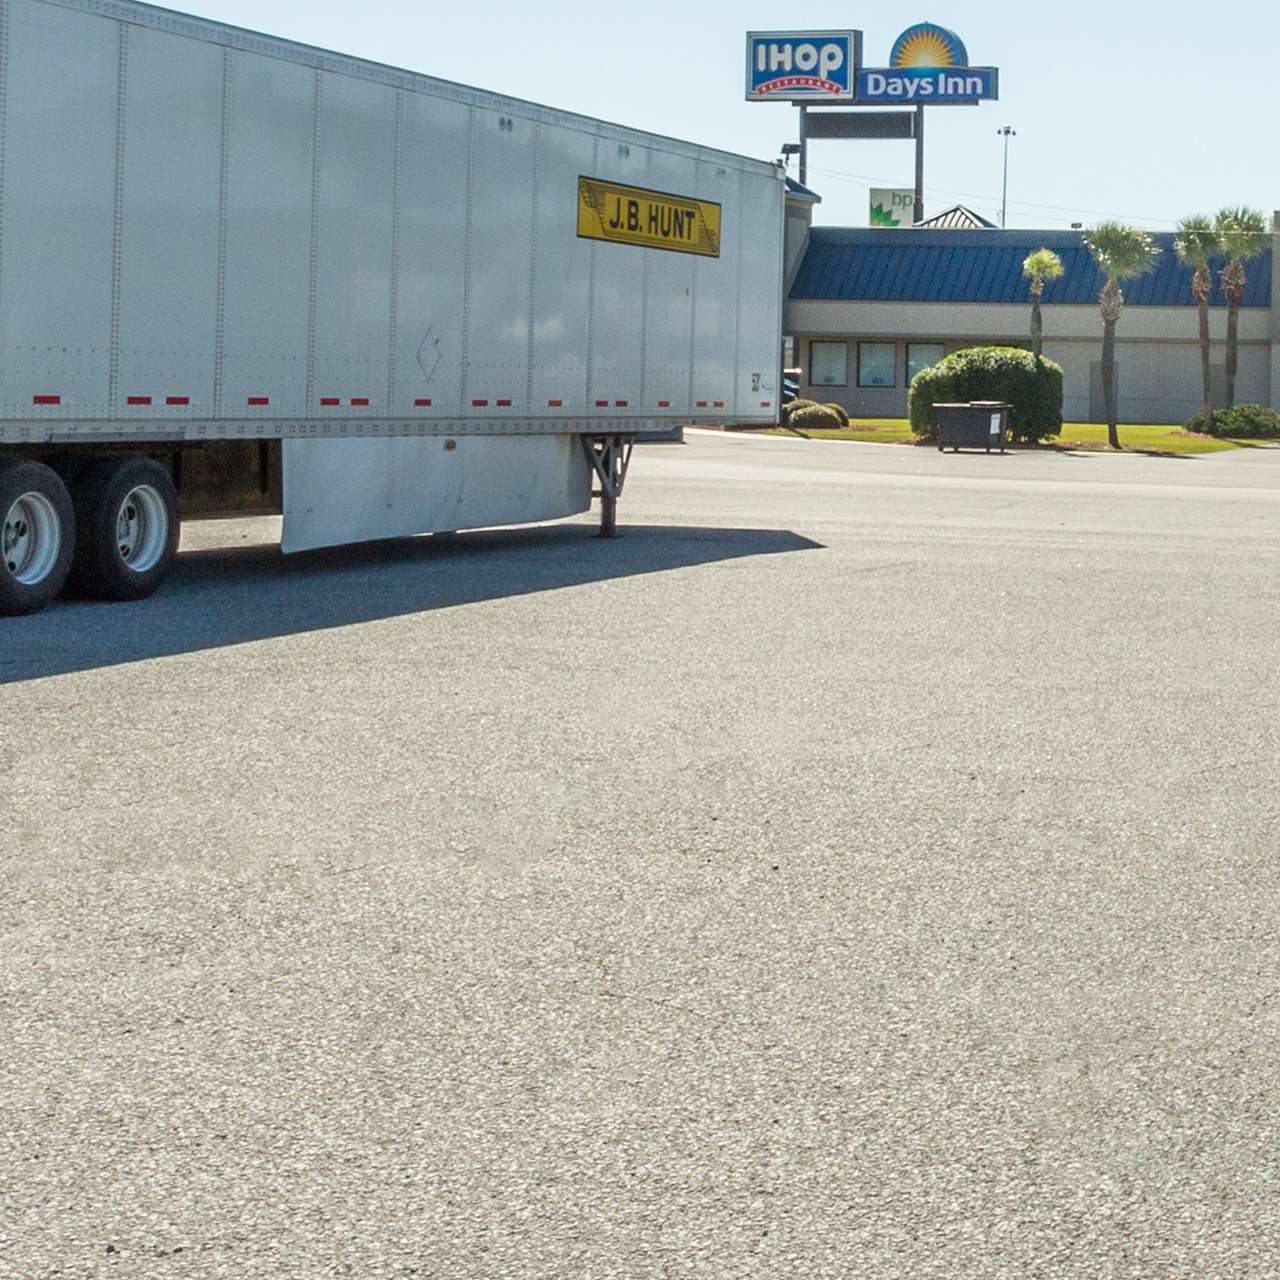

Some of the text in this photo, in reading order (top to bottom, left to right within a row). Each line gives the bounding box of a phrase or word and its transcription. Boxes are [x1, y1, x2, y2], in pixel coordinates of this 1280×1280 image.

[757, 43, 844, 81] IHOP
[866, 73, 983, 98] Days Inn
[891, 191, 913, 210] bp
[647, 203, 696, 241] HUNT
